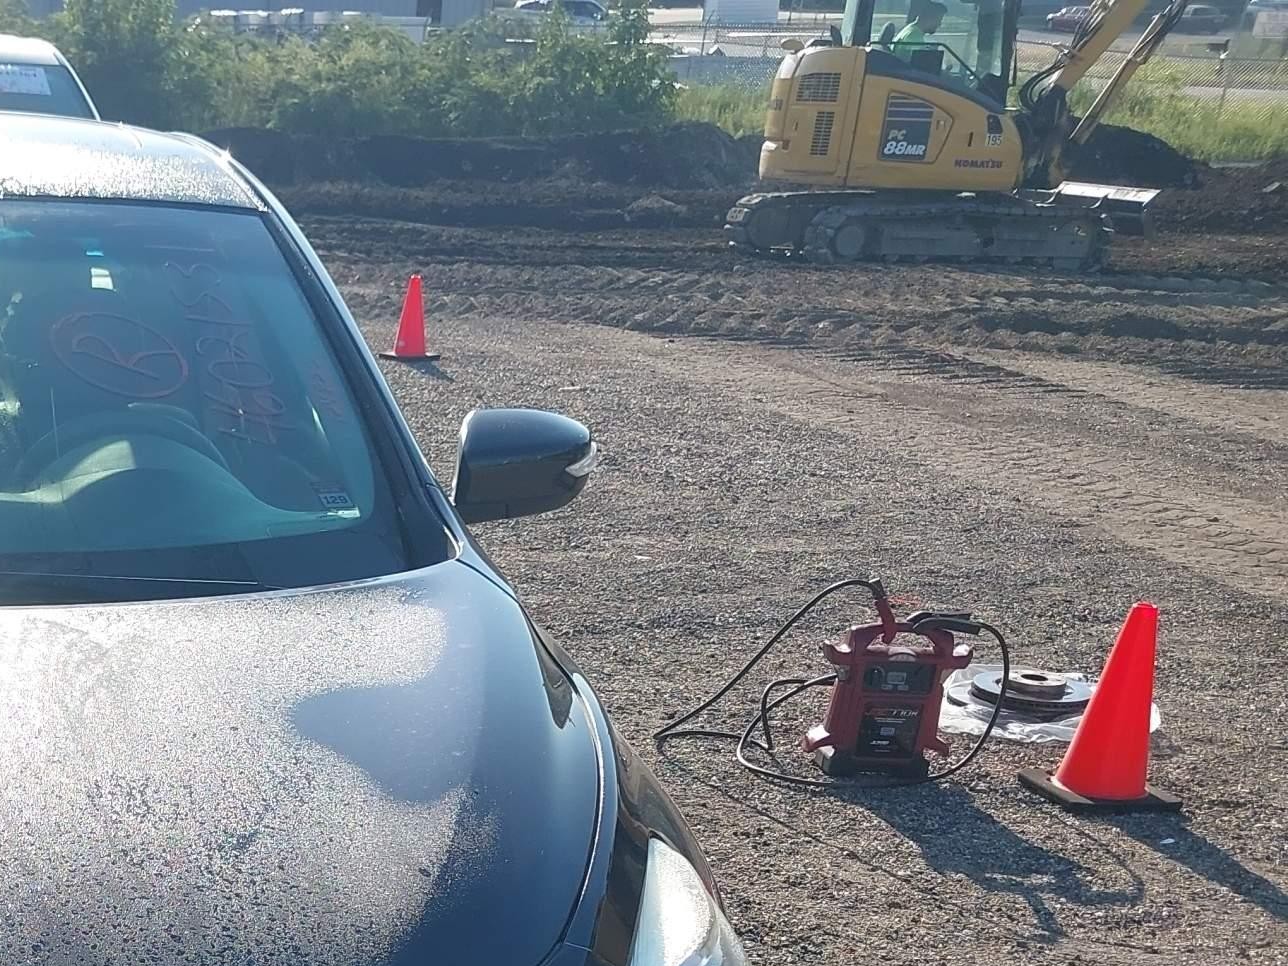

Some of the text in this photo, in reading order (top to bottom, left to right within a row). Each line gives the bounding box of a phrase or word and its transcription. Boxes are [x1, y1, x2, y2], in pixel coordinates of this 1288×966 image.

[888, 130, 907, 140] PC
[883, 141, 926, 155] 88MR
[954, 159, 1002, 169] KOMATSU
